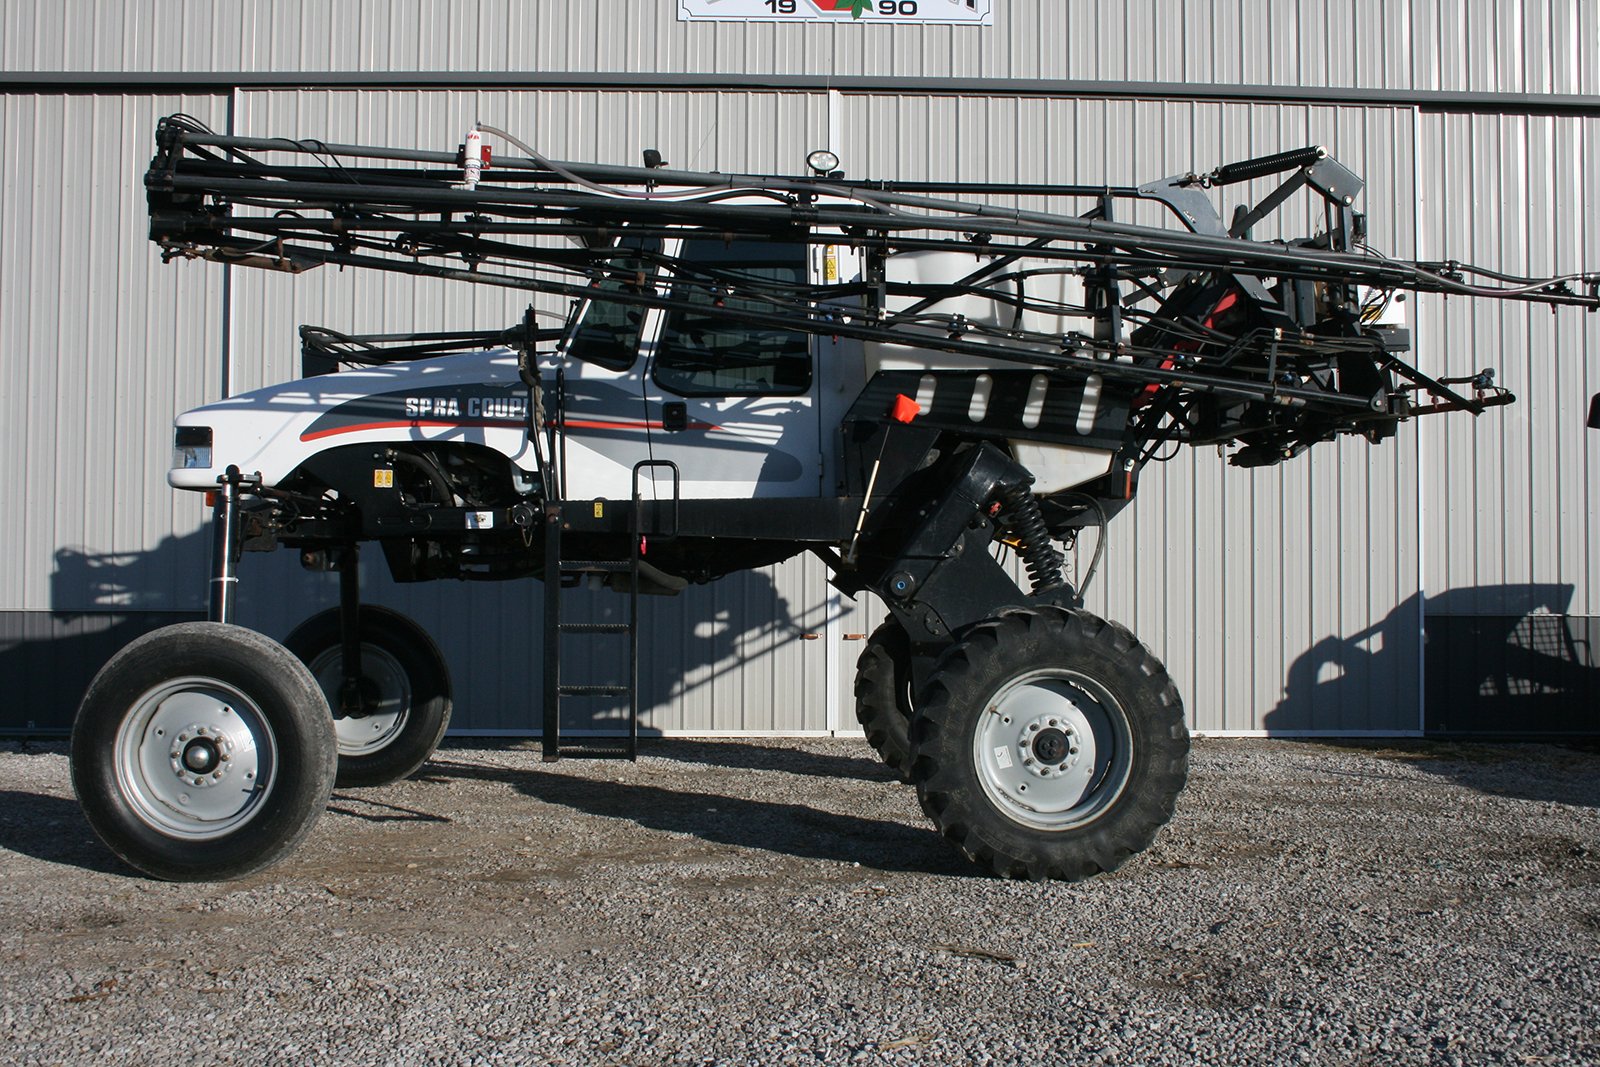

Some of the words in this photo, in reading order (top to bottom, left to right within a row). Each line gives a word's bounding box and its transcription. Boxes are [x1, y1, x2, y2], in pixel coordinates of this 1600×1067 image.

[764, 0, 797, 14] 19
[878, 0, 918, 15] 90
[405, 397, 460, 417] SPRA
